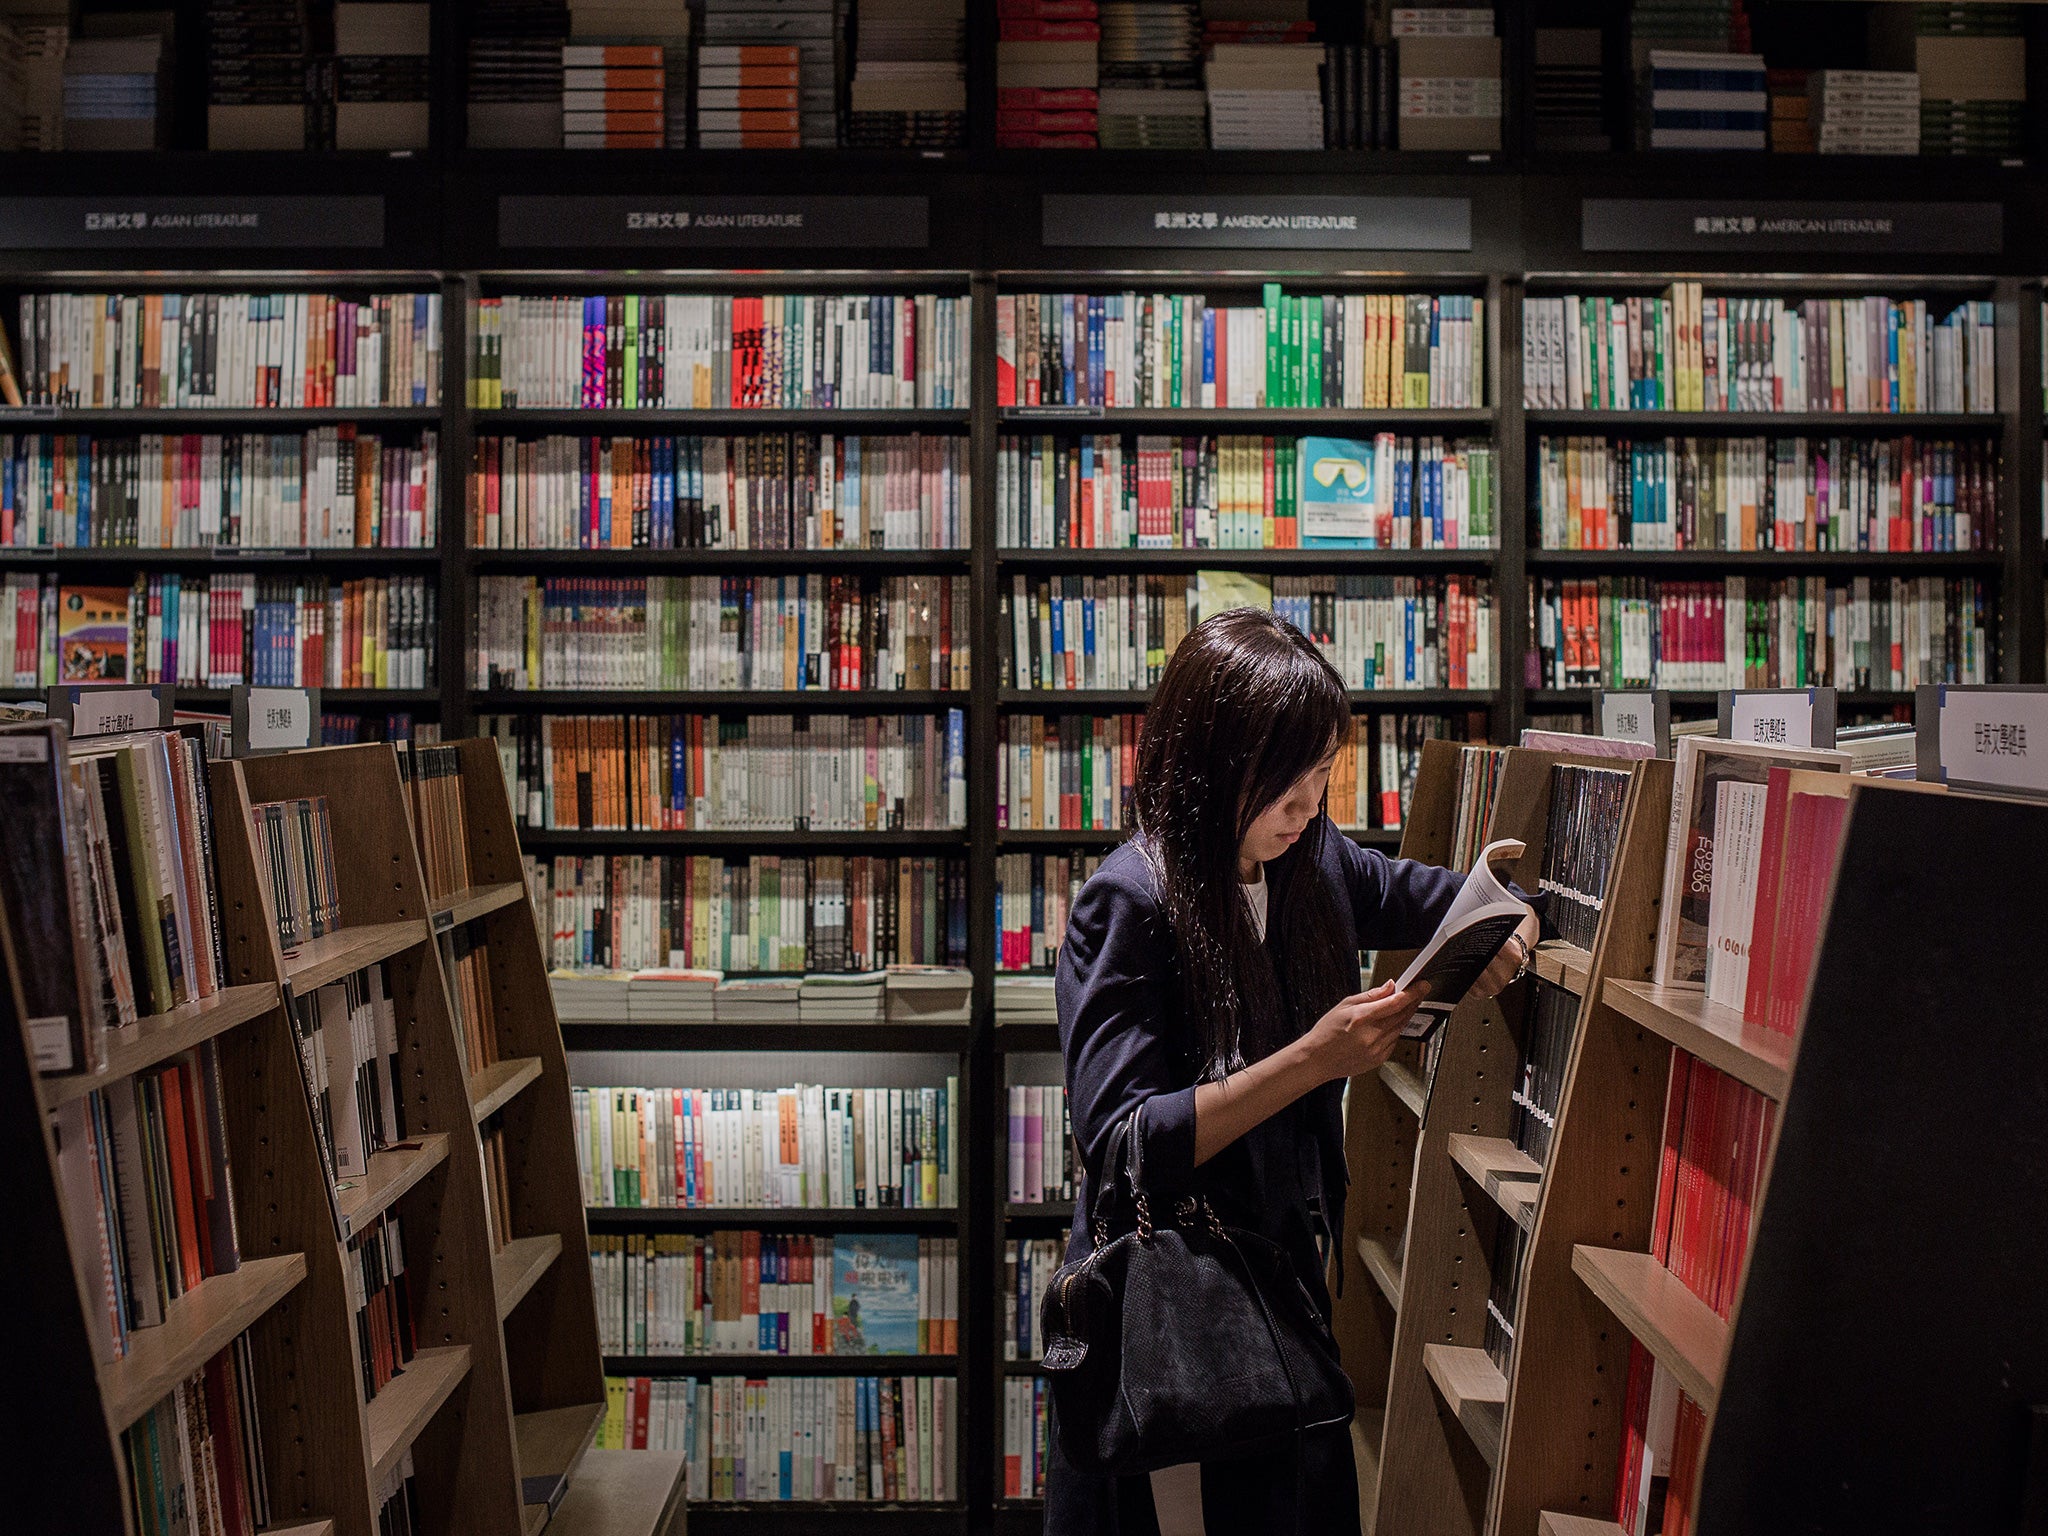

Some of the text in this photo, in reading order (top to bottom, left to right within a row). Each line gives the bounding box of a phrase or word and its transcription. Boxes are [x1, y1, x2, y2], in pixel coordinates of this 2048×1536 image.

[151, 215, 191, 228] ASIAN
[194, 214, 258, 227] LITERATURE
[694, 215, 735, 227] ASIAN
[737, 214, 803, 227] LITERATURE
[1221, 216, 1289, 229] AMERICAN
[1291, 216, 1357, 230] LITERATURE
[1760, 219, 1826, 233] AMERICAN
[1828, 219, 1893, 233] LITERATURE
[1975, 722, 2027, 757] 世界文學經典
